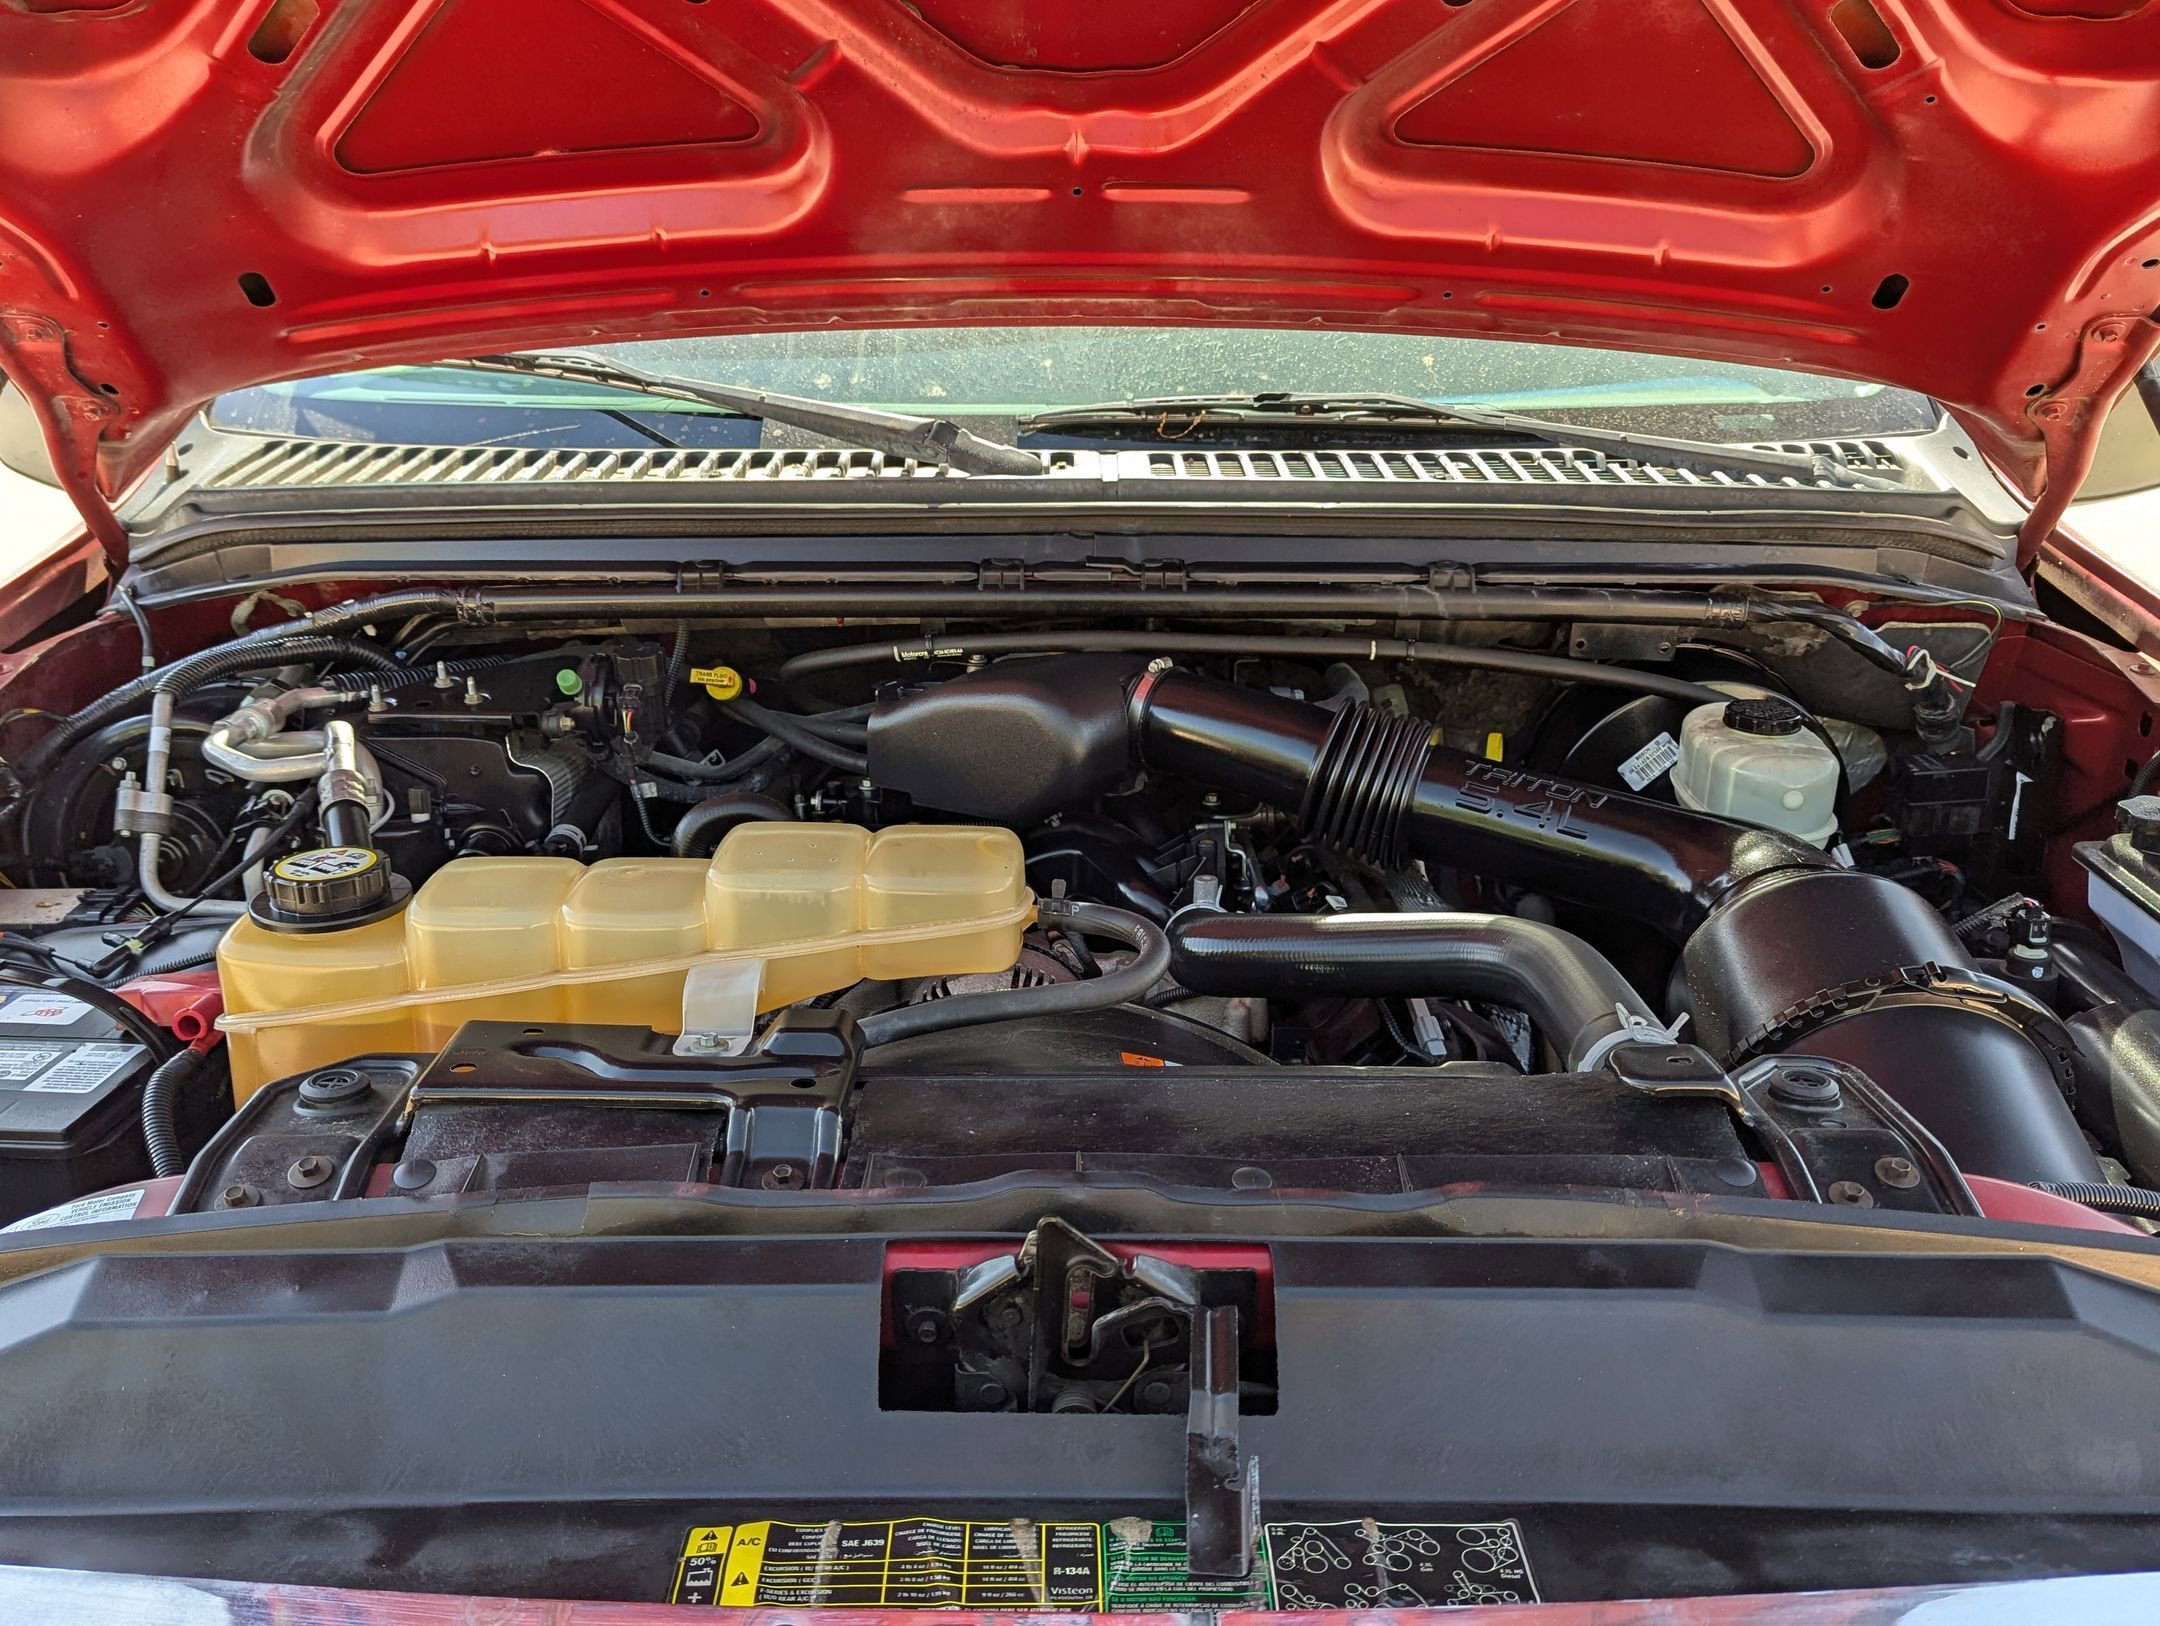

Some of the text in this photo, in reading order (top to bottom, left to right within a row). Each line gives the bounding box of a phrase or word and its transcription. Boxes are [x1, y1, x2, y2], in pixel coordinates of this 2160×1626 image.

[1465, 760, 1608, 809] TRITON
[1455, 781, 1589, 840] 5.4L
[99, 1198, 131, 1208] EMISSION
[91, 1202, 137, 1215] INFORMATION
[736, 1537, 761, 1547] A/C
[841, 1539, 885, 1547] SAE J639
[689, 1557, 717, 1566] 50%
[1053, 1566, 1091, 1575] R-134A
[1050, 1586, 1093, 1595] Visteon
